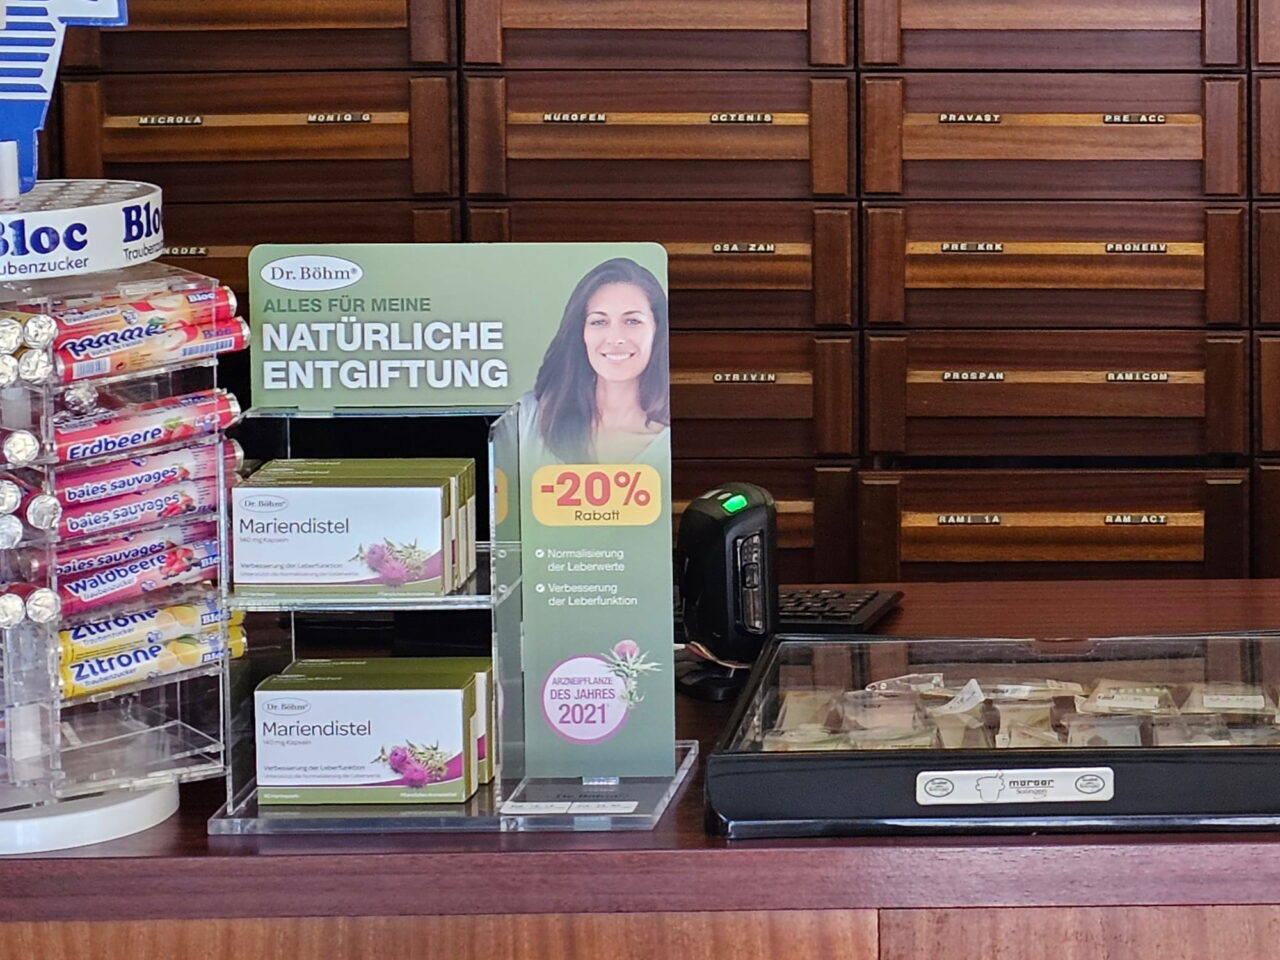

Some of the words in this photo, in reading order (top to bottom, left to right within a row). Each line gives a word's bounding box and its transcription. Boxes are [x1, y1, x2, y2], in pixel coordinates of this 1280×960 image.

[139, 116, 201, 125] MICROLA
[544, 113, 606, 122] NUROFEN
[271, 267, 296, 280] Dr.
[263, 298, 323, 313] ALLES
[328, 295, 365, 312] FÜR
[371, 298, 431, 312] MEINE
[263, 316, 504, 352] NATÜRLICHE
[264, 359, 508, 390] ENTGIFTUNG
[69, 427, 162, 460] Erdbeere
[67, 483, 108, 500] baies
[110, 467, 177, 490] sauvages
[541, 472, 651, 507] -20%
[69, 509, 110, 531] baies
[113, 492, 180, 521] sauvages
[574, 510, 620, 521] Rabatt
[1106, 515, 1131, 524] RAM
[1140, 515, 1166, 524] ACT
[240, 518, 349, 534] Mariendistel
[99, 542, 165, 568] sauvages
[548, 549, 624, 560] Normalisierung
[67, 554, 167, 594] Waldbeere
[548, 563, 565, 572] der
[567, 563, 624, 572] Leberwerte
[548, 584, 617, 594] Verbesserung
[548, 597, 565, 606] der
[568, 596, 638, 606] Leberfunktion
[70, 645, 162, 682] Zitrone
[550, 689, 571, 700] DES
[574, 689, 615, 700] JAHRES
[558, 704, 607, 724] 2021
[263, 721, 371, 736] Mariendistel
